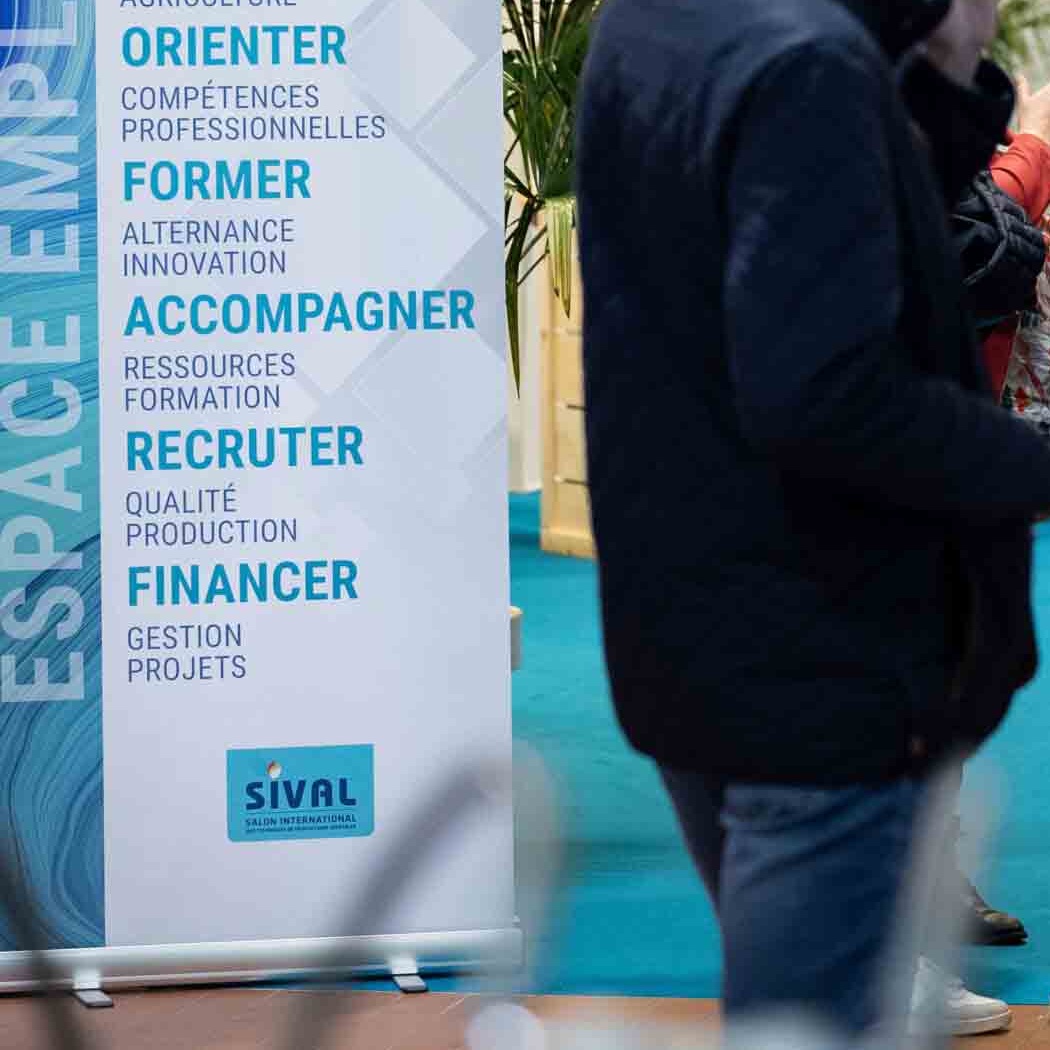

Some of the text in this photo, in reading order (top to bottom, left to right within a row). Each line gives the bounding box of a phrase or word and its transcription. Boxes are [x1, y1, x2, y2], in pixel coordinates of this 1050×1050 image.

[121, 26, 347, 67] ORIENTER
[121, 80, 319, 111] COMPÉTENCES
[121, 116, 386, 142] PROFESSIONNELLES
[123, 160, 311, 201] FORMER
[122, 219, 294, 245] ALTERNANCE
[123, 251, 286, 276] INNOVATION
[124, 290, 475, 336] ACCOMPAGNER
[124, 354, 295, 380] RESSOURCES
[125, 386, 280, 412] FORMATION
[127, 425, 364, 471] RECRUTER
[0, 311, 87, 703] ESPACE
[126, 484, 237, 516] QUALITÉ
[127, 519, 297, 546] PRODUCTION
[128, 560, 359, 607] FINANCER
[127, 624, 242, 650] GESTION
[128, 656, 247, 683] PROJETS
[246, 778, 357, 810] SIVAL
[246, 814, 356, 826] SALON INTERNATIONAL
